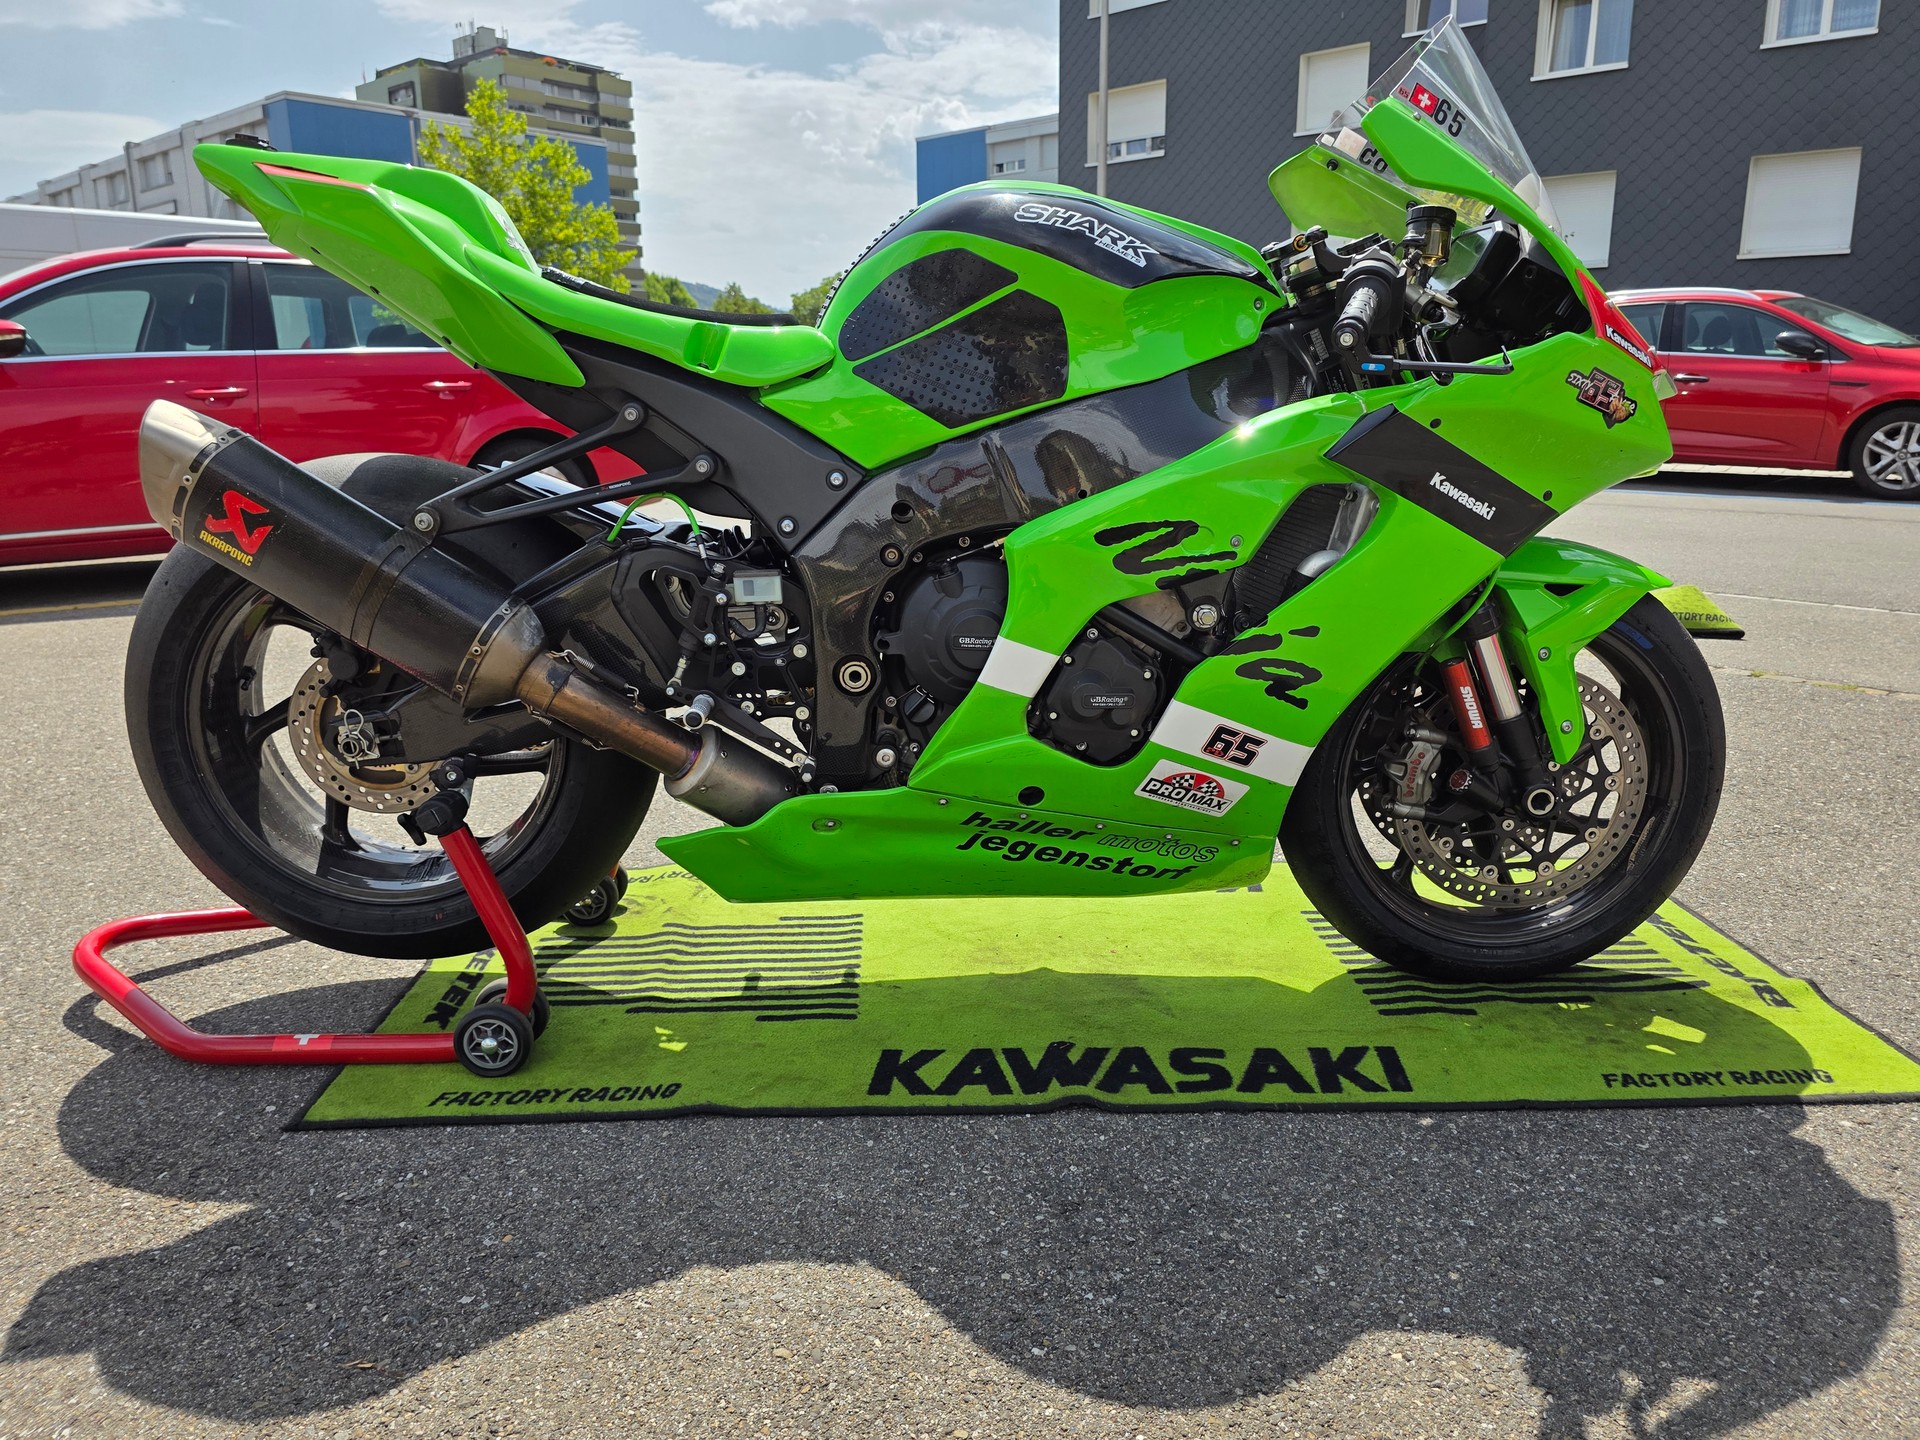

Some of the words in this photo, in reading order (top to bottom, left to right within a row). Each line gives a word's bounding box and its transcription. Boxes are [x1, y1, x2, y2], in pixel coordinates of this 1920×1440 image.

[1433, 98, 1467, 138] 65
[1013, 203, 1161, 264] SHARK
[1099, 240, 1142, 265] HELMETS
[1605, 324, 1652, 369] Kawasaki
[1429, 471, 1497, 521] Kawasaki
[1460, 686, 1484, 729] SHOWA
[1201, 723, 1269, 768] 65
[1145, 779, 1187, 800] PRO
[1186, 791, 1228, 811] MAX
[1403, 751, 1426, 798] brembo
[955, 829, 1200, 880] jegenstorf
[960, 811, 1097, 841] haller
[1097, 832, 1220, 863] motos
[866, 1041, 1413, 1096] KAWASAKI
[1601, 1071, 1726, 1089] FACTORY
[1729, 1068, 1835, 1085] RACING
[428, 1088, 573, 1108] FACTORY
[568, 1082, 683, 1102] RACING
